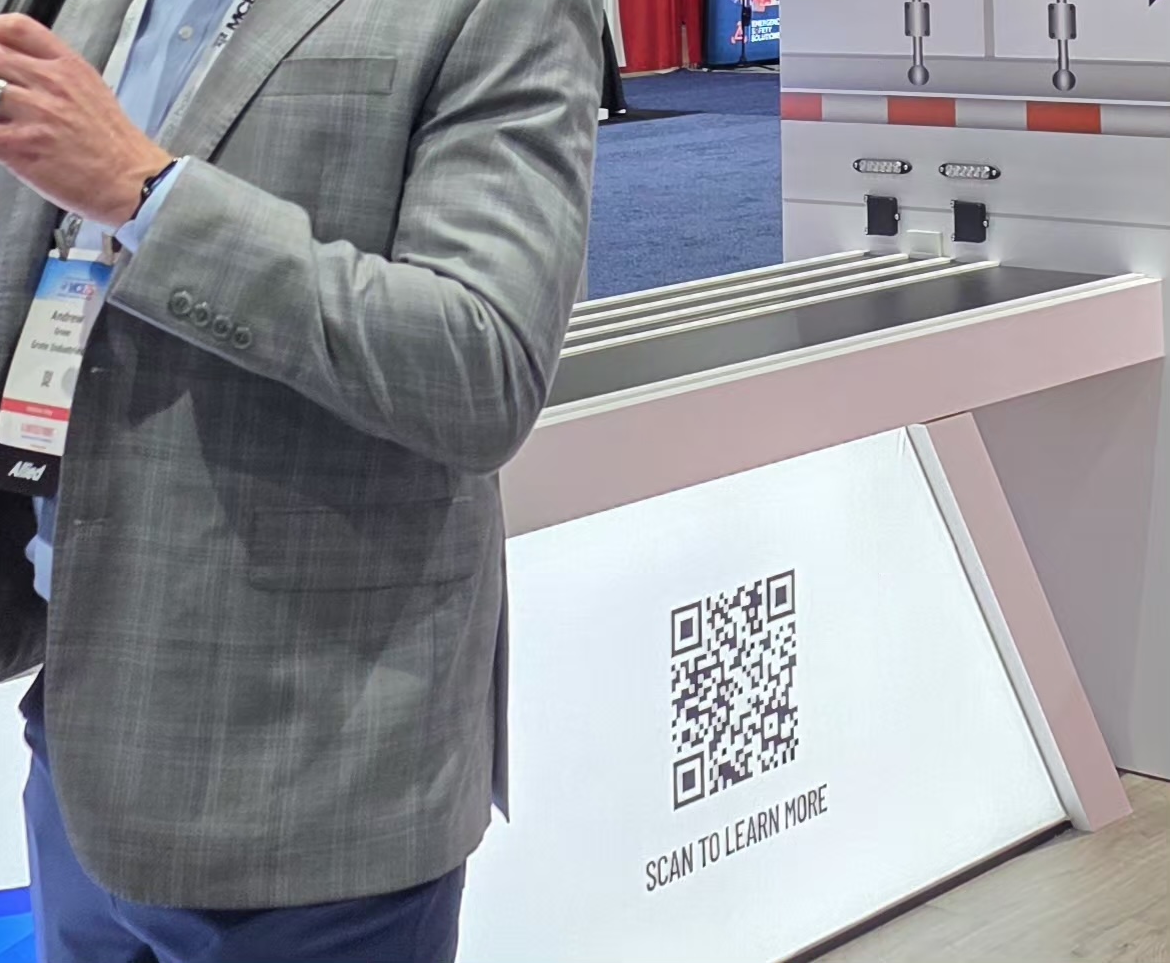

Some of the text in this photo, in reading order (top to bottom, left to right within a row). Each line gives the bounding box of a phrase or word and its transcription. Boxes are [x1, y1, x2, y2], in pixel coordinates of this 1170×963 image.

[646, 783, 828, 892] SCAN TO LEARN MORE
